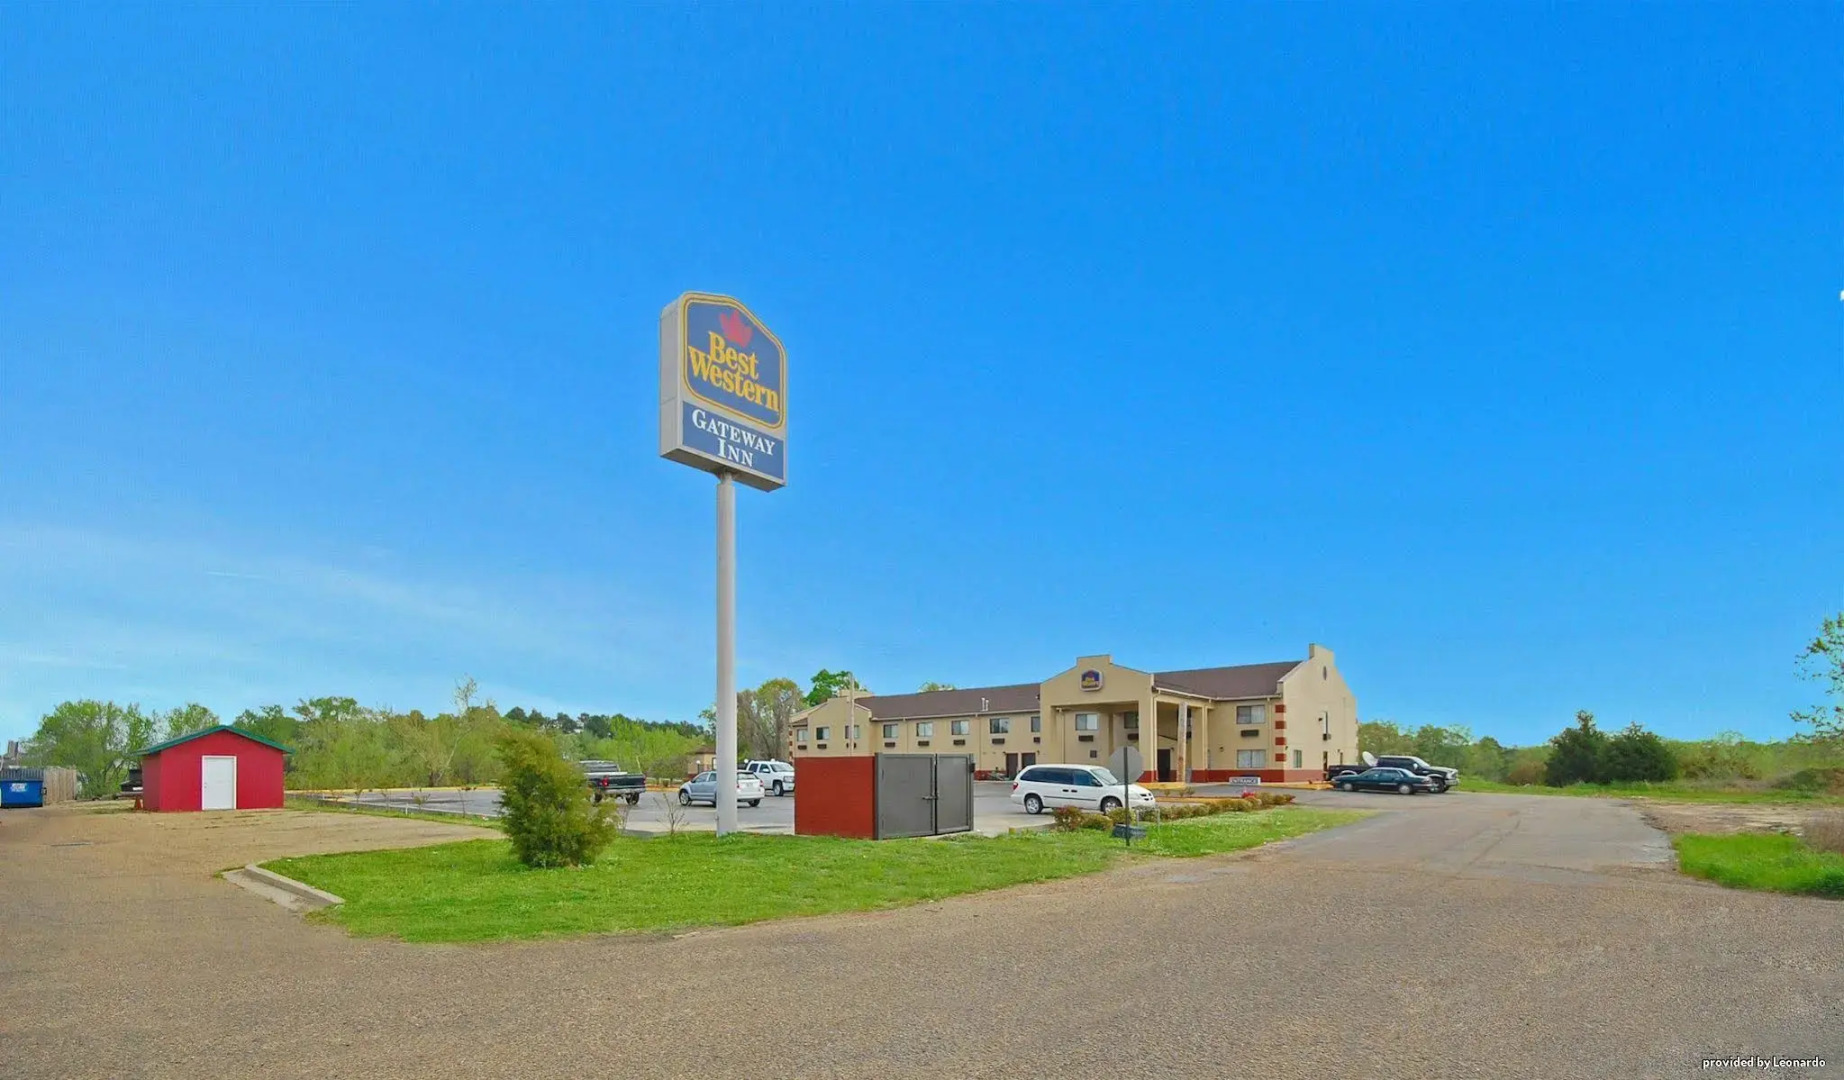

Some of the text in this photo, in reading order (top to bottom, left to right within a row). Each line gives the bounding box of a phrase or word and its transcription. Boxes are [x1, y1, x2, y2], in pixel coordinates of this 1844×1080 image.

[688, 346, 779, 412] Western
[709, 331, 759, 380] Best
[692, 409, 775, 456] GATEWAY
[718, 438, 753, 468] INN
